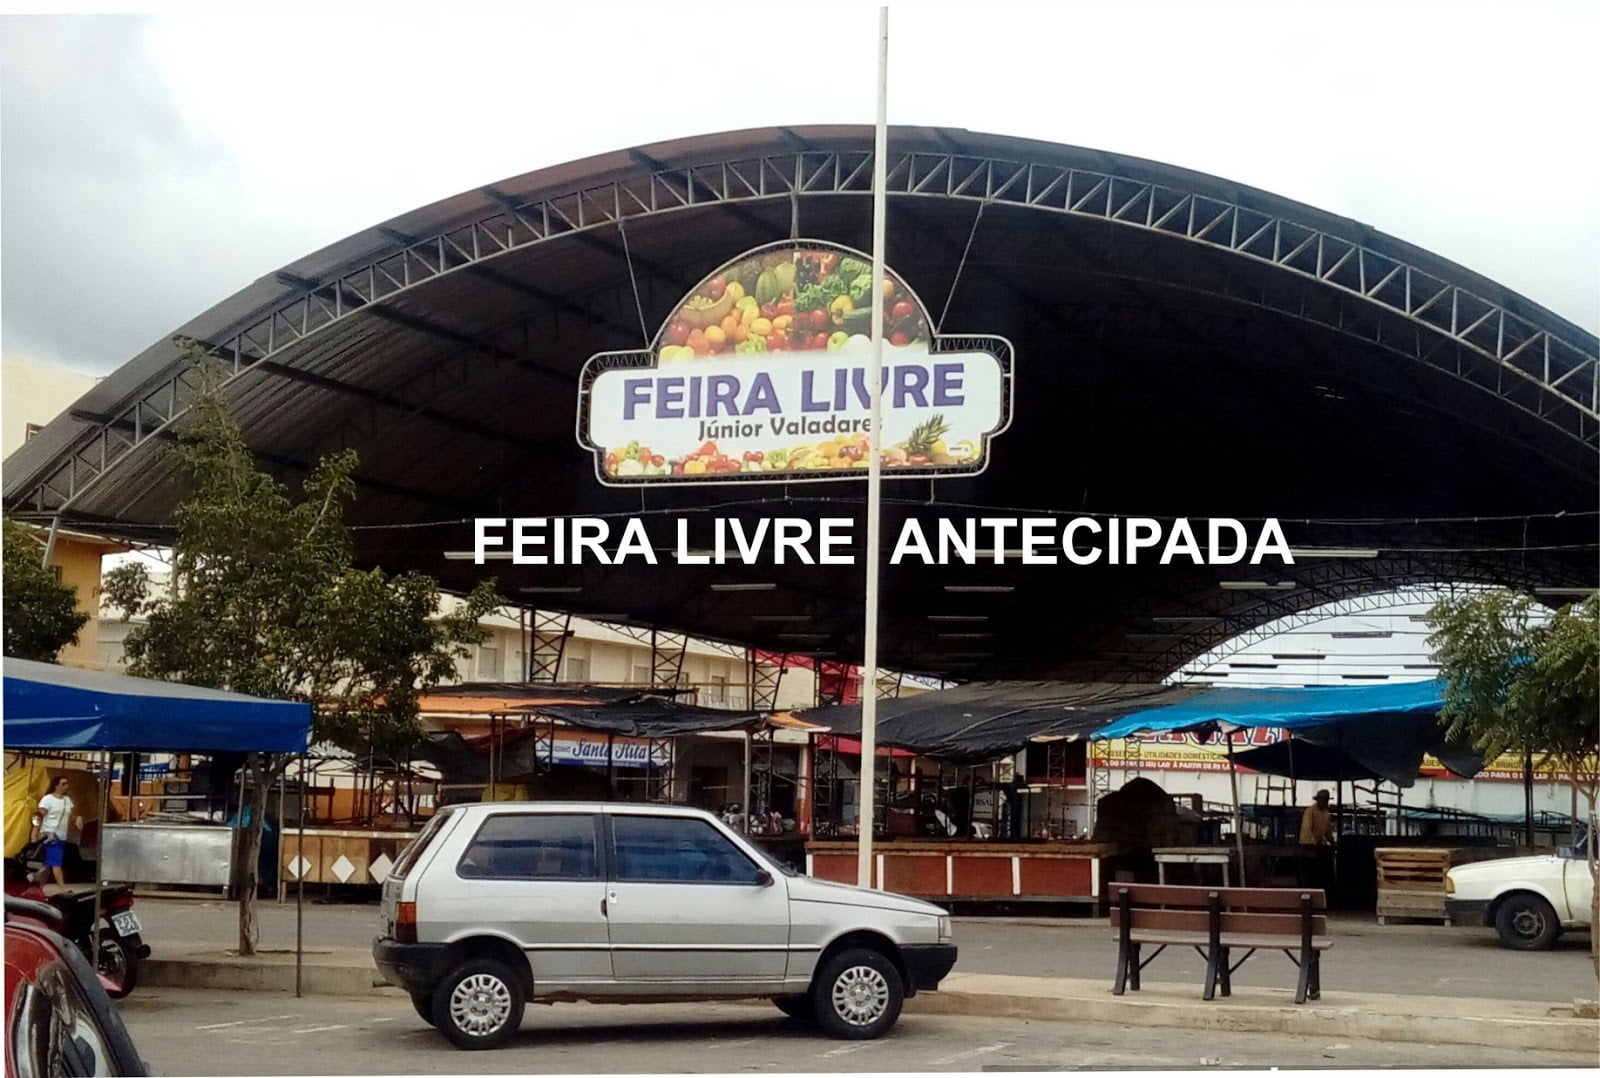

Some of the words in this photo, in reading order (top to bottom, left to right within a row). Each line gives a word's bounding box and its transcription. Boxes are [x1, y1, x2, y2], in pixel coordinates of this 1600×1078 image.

[623, 372, 782, 420] FEIRA
[800, 363, 965, 412] LIVRE
[698, 420, 763, 442] Júnior
[615, 740, 647, 759] Rita
